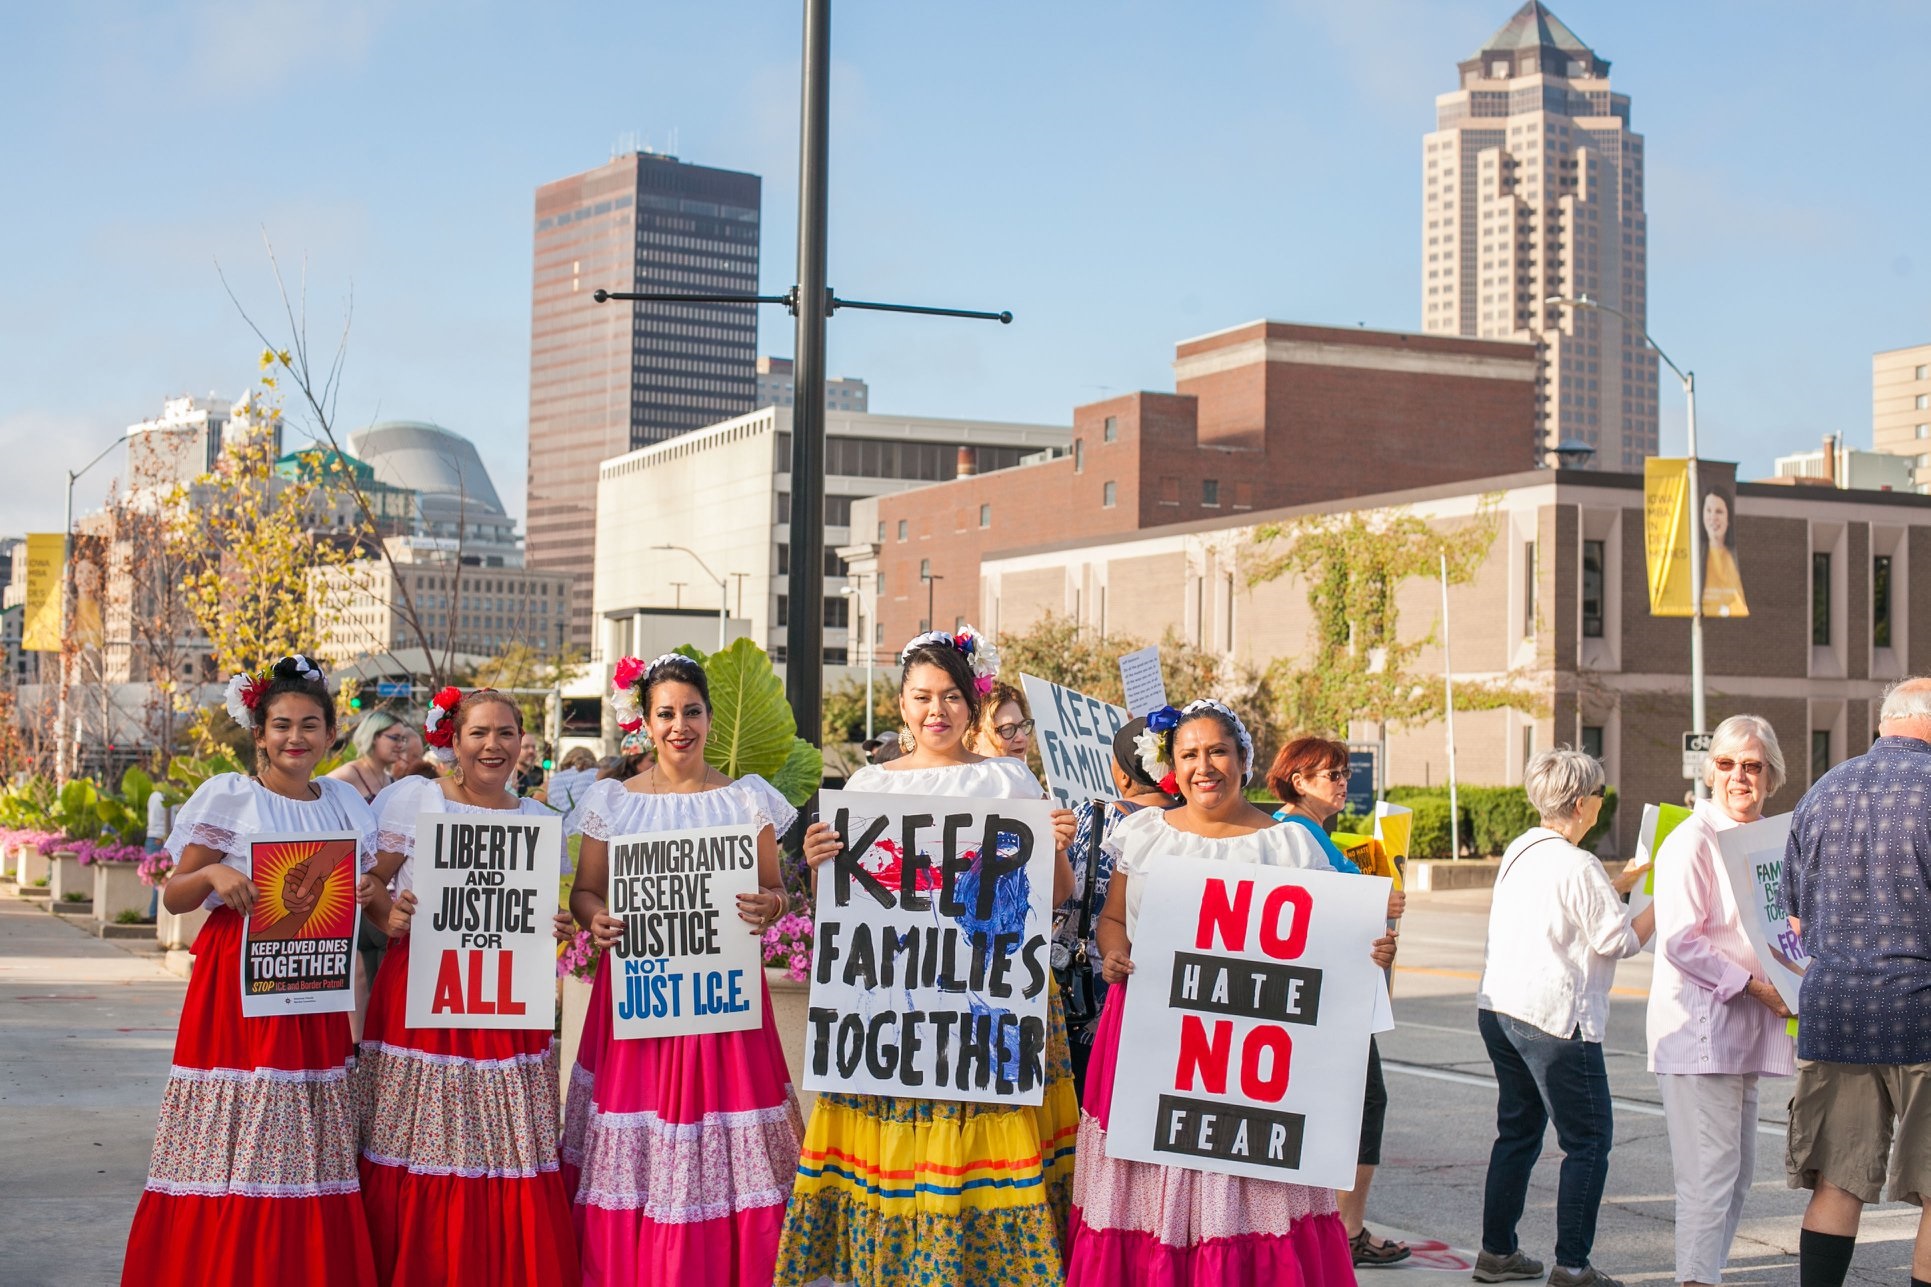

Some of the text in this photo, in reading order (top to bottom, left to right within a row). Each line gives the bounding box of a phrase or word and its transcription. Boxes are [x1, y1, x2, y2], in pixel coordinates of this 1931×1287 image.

[1050, 682, 1121, 746] KEEP
[434, 823, 540, 871] LIBERTY
[613, 834, 754, 877] IMMIGRANTS
[833, 807, 1034, 920] KEEP
[465, 870, 505, 886] AND
[613, 873, 713, 913] DESERVE
[1756, 860, 1782, 884] FAM
[433, 886, 537, 934] JUSTICE
[1195, 877, 1314, 960] NO
[1764, 903, 1788, 922] TOG
[251, 939, 348, 956] KEEP LOVED ONES
[461, 933, 502, 949] FOR
[615, 910, 721, 959] JUSTICE
[250, 953, 347, 980] TOGETHER
[431, 949, 526, 1015] ALL
[624, 958, 670, 975] NOT
[816, 921, 1047, 1000] FAMILIES
[251, 980, 275, 993] STOP
[275, 981, 286, 991] ICE
[287, 981, 300, 991] and
[300, 980, 322, 990] Border
[618, 969, 750, 1020] JUST I.C.E.
[1181, 963, 1304, 1015] HATE
[808, 1006, 1046, 1095] TOGETHER
[1174, 1014, 1293, 1103] NO
[1168, 1110, 1287, 1160] FEAR
